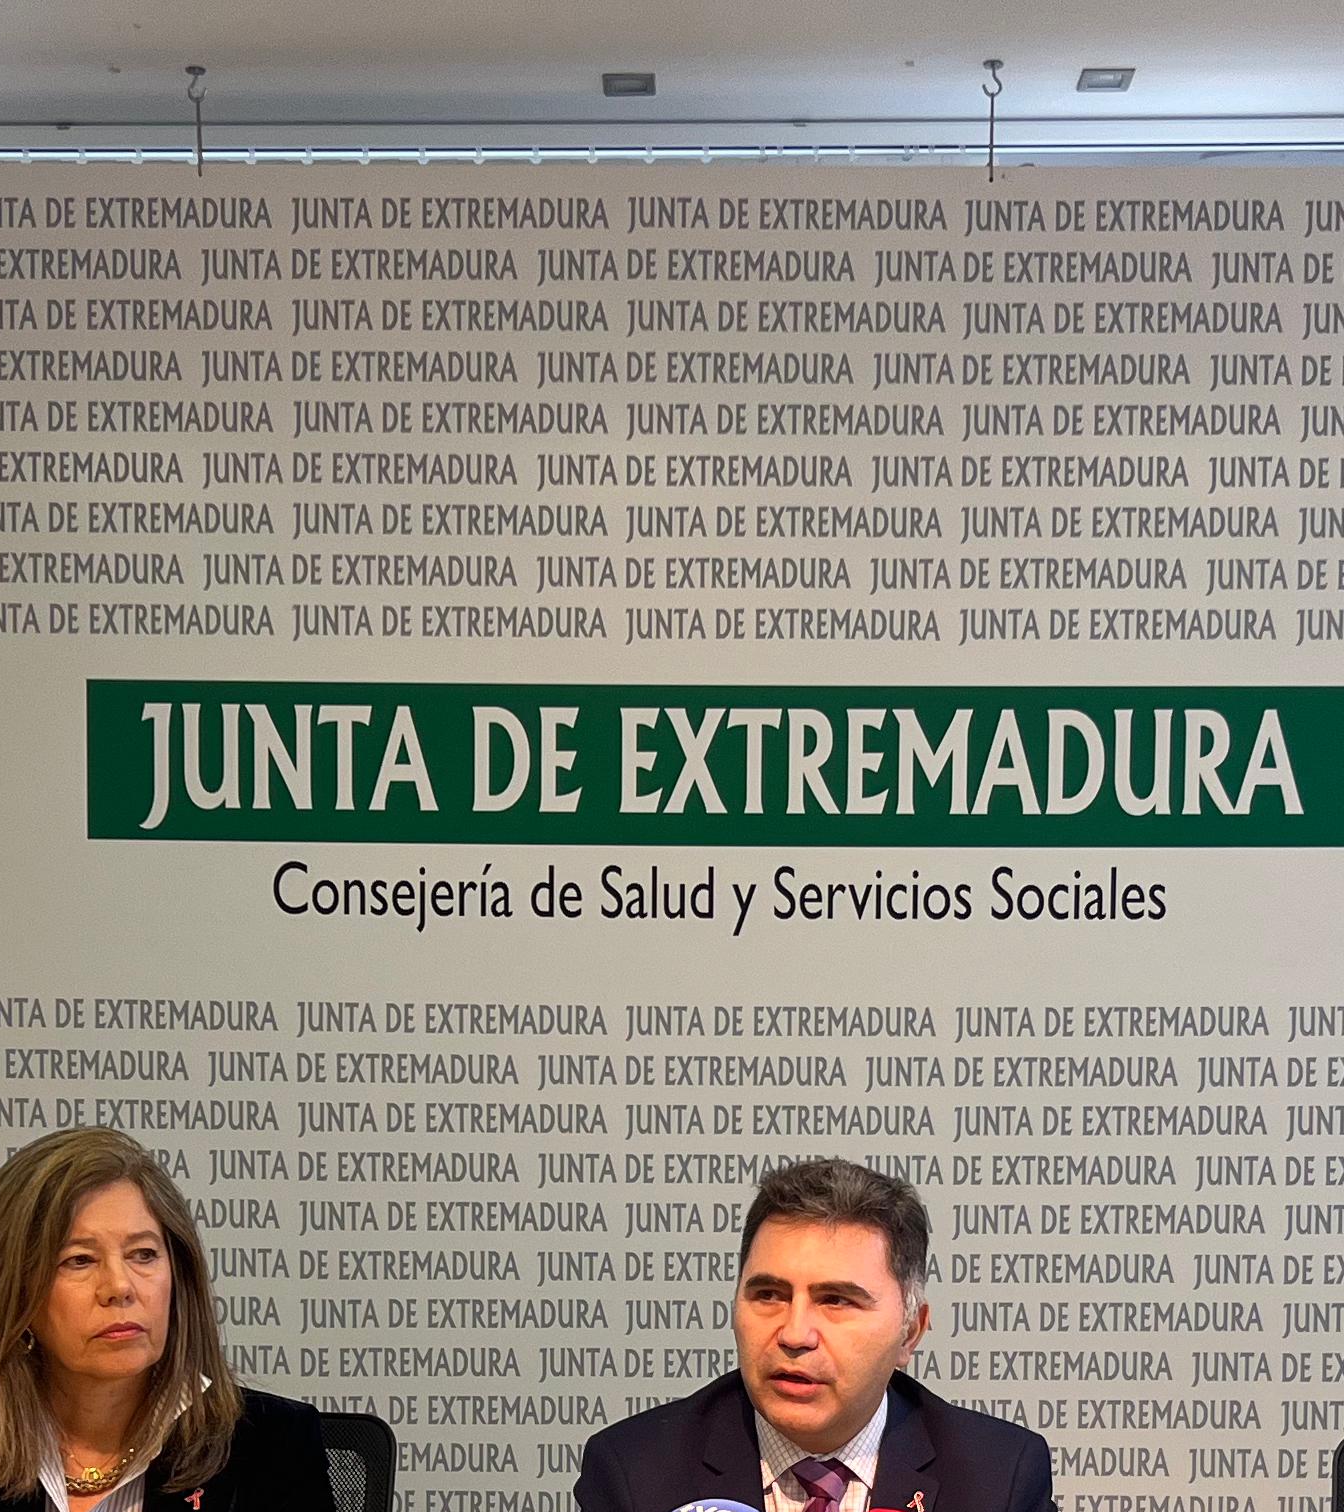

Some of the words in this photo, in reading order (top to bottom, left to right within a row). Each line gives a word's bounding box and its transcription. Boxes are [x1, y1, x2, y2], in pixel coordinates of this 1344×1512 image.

[45, 196, 77, 229] DE
[85, 196, 273, 230] EXTREMADURA
[290, 196, 374, 236] JUNTA
[381, 196, 413, 230] DE
[421, 196, 610, 230] EXTREMADURA
[626, 195, 710, 235] JUNTA
[718, 197, 750, 231] DE
[758, 197, 948, 232] EXTREMADURA
[963, 199, 1047, 238] JUNTA
[1054, 199, 1087, 233] DE
[1095, 199, 1285, 233] EXTREMADURA
[200, 247, 283, 287] JUNTA
[291, 247, 323, 281] DE
[330, 247, 519, 281] EXTREMADURA
[536, 248, 620, 288] JUNTA
[626, 247, 658, 281] DE
[667, 248, 856, 283] EXTREMADURA
[873, 249, 958, 289] JUNTA
[962, 250, 995, 284] DE
[1003, 250, 1193, 284] EXTREMADURA
[1210, 251, 1295, 291] JUNTA
[1302, 251, 1335, 285] DE
[46, 298, 78, 331] DE
[86, 298, 274, 332] EXTREMADURA
[291, 298, 374, 338] JUNTA
[381, 298, 413, 332] DE
[421, 298, 610, 333] EXTREMADURA
[625, 298, 710, 339] JUNTA
[717, 299, 749, 333] DE
[757, 299, 947, 334] EXTREMADURA
[962, 301, 1046, 341] JUNTA
[1053, 301, 1086, 335] DE
[1093, 300, 1284, 335] EXTREMADURA
[138, 702, 438, 829] JUNTA
[472, 706, 582, 812] DE
[619, 707, 1304, 815] EXTREMADURA
[273, 861, 513, 932] Consejería
[531, 865, 582, 918] de
[600, 865, 714, 919] Salud
[732, 883, 756, 936] y
[774, 866, 972, 920] Servicios
[991, 867, 1167, 920] Sociales
[54, 997, 86, 1030] DE
[93, 997, 280, 1032] EXTREMADURA
[295, 1000, 378, 1039] JUNTA
[384, 1002, 417, 1035] DE
[424, 1002, 609, 1037] EXTREMADURA
[624, 1004, 706, 1043] JUNTA
[713, 1005, 745, 1037] DE
[752, 1005, 937, 1038] EXTREMADURA
[953, 1005, 1037, 1044] JUNTA
[1043, 1005, 1077, 1038] DE
[1083, 1004, 1271, 1038] EXTREMADURA
[4, 1047, 190, 1082] EXTREMADURA
[207, 1050, 290, 1088] JUNTA
[295, 1051, 328, 1084] DE
[335, 1051, 520, 1086] EXTREMADURA
[536, 1053, 619, 1092] JUNTA
[624, 1054, 656, 1087] DE
[664, 1054, 848, 1088] EXTREMADURA
[864, 1055, 946, 1094] JUNTA
[953, 1055, 985, 1088] DE
[992, 1055, 1179, 1088] EXTREMADURA
[1196, 1055, 1280, 1094] JUNTA
[1286, 1055, 1319, 1088] DE
[297, 1199, 380, 1237] JUNTA
[386, 1200, 419, 1232] DE
[425, 1200, 609, 1233] EXTREMADURA
[624, 1201, 706, 1240] JUNTA
[712, 1202, 743, 1234] DE
[950, 1203, 1033, 1242] JUNTA
[1040, 1203, 1073, 1236] DE
[1079, 1203, 1267, 1236] EXTREMADURA
[299, 1346, 331, 1378] DE
[338, 1346, 522, 1378] EXTREMADURA
[537, 1346, 619, 1384] JUNTA
[623, 1347, 655, 1379] DE
[949, 1349, 981, 1382] DE
[988, 1349, 1174, 1382] EXTREMADURA
[1190, 1351, 1273, 1389] JUNTA
[1281, 1351, 1313, 1384] DE
[1187, 1447, 1271, 1485] JUNTA
[1276, 1448, 1309, 1480] DE
